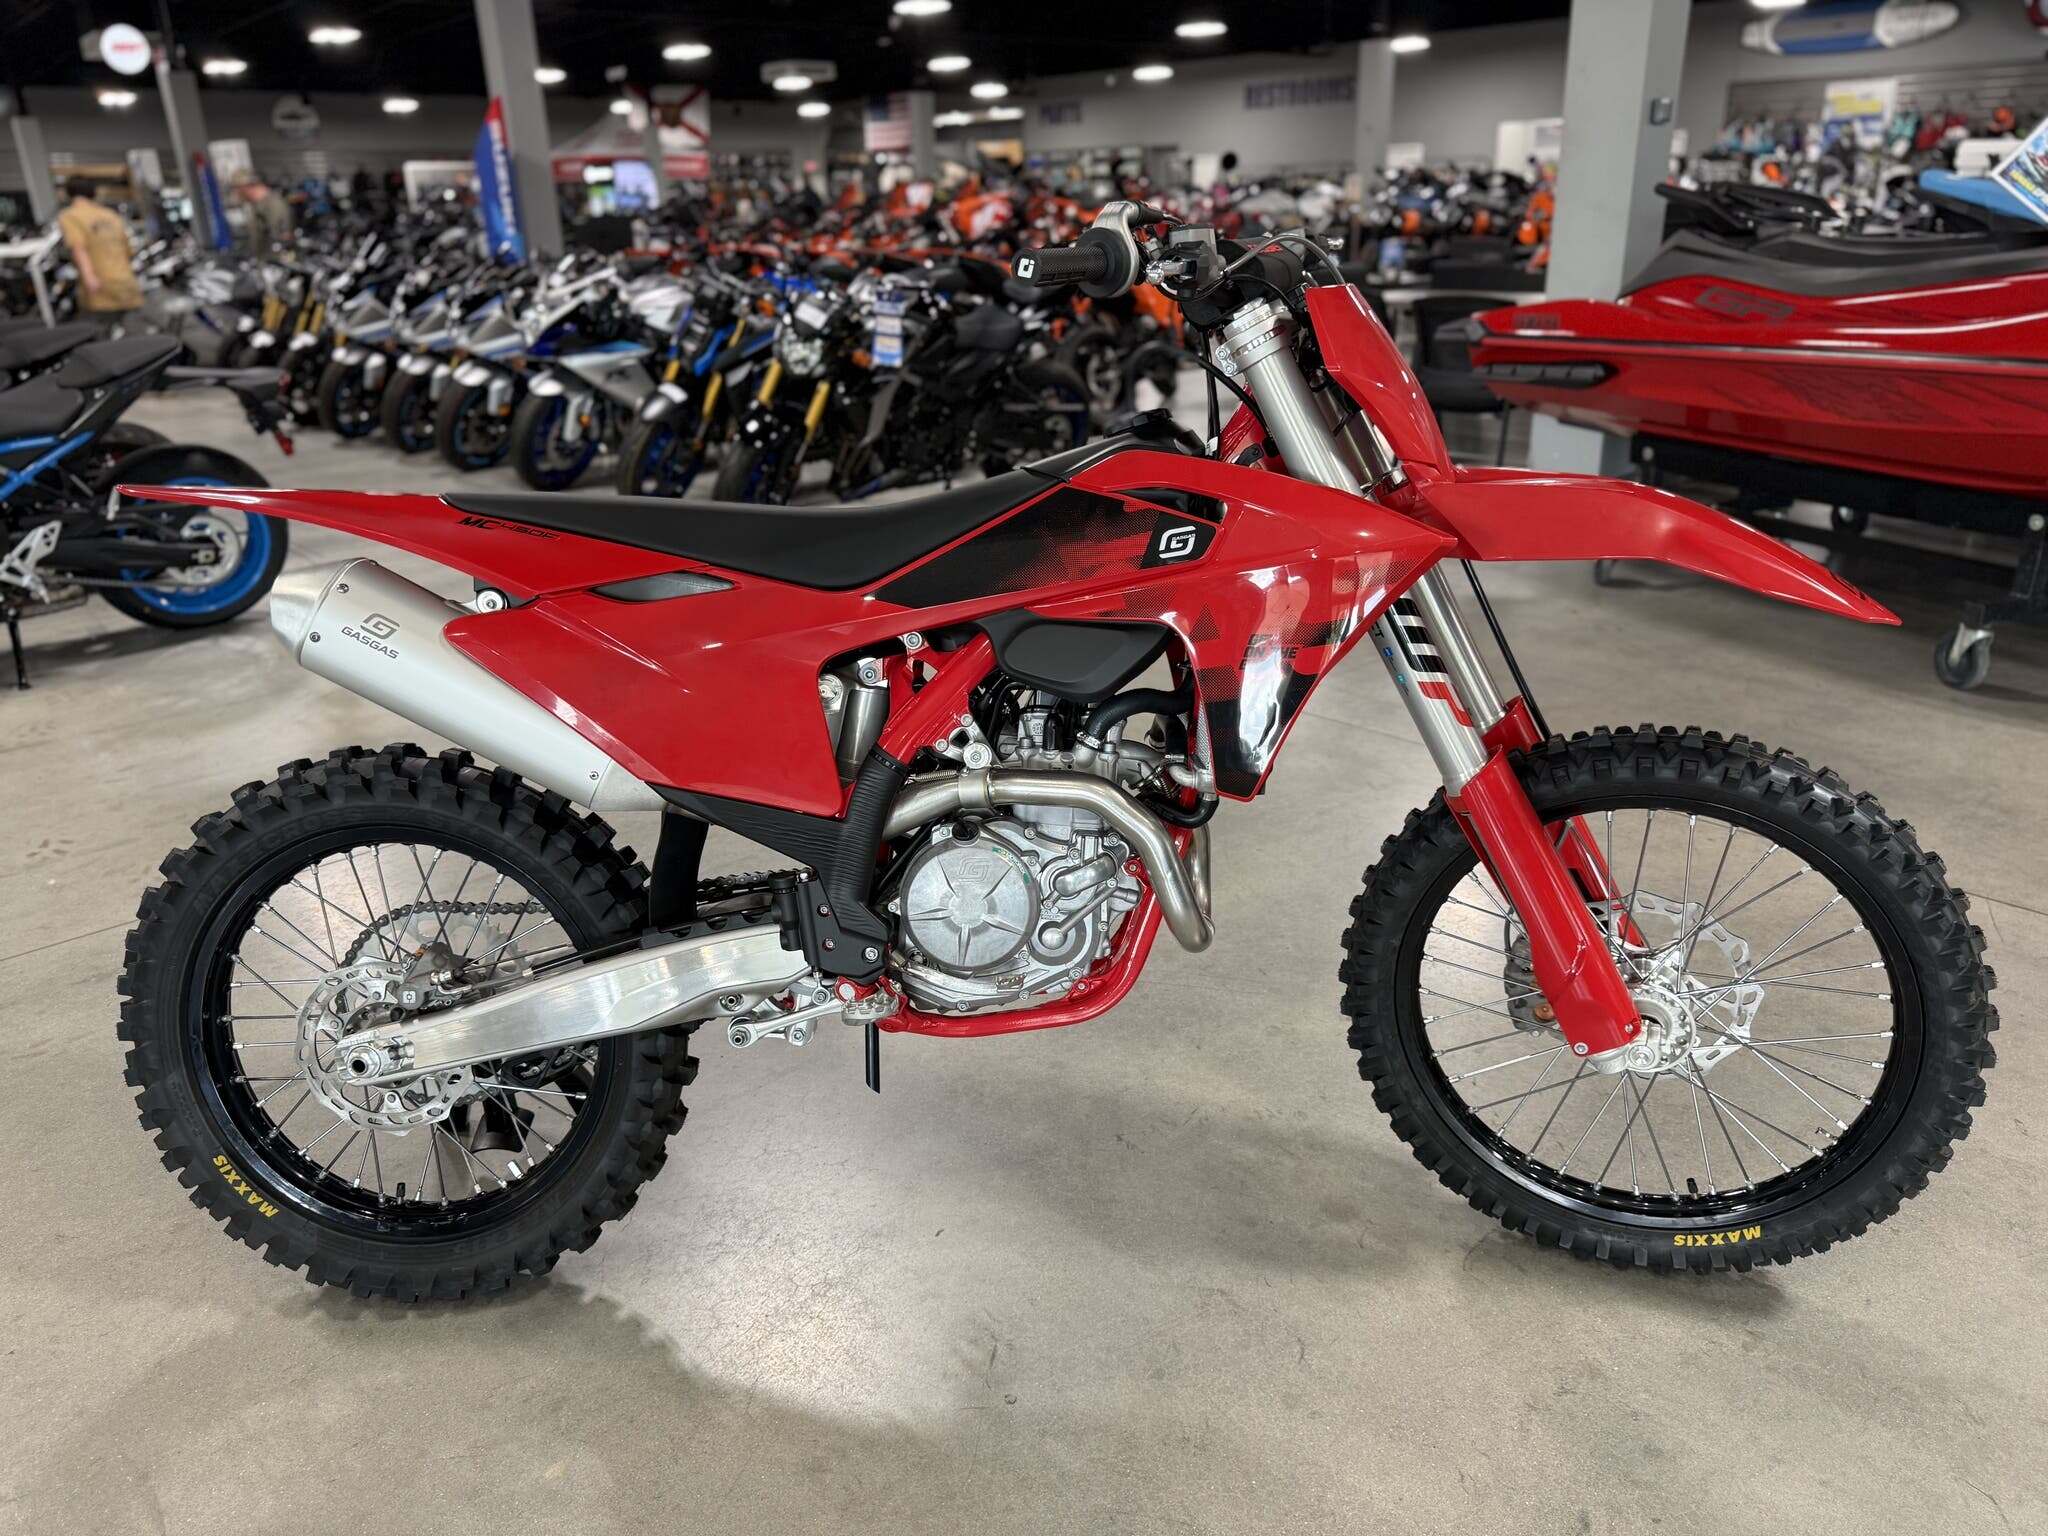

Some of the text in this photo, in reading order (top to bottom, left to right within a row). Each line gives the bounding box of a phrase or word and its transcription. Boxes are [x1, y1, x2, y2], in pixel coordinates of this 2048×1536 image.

[341, 626, 400, 659] GASGAS
[212, 1154, 280, 1218] MAXXIS
[1673, 1225, 1761, 1247] MAXXIS
